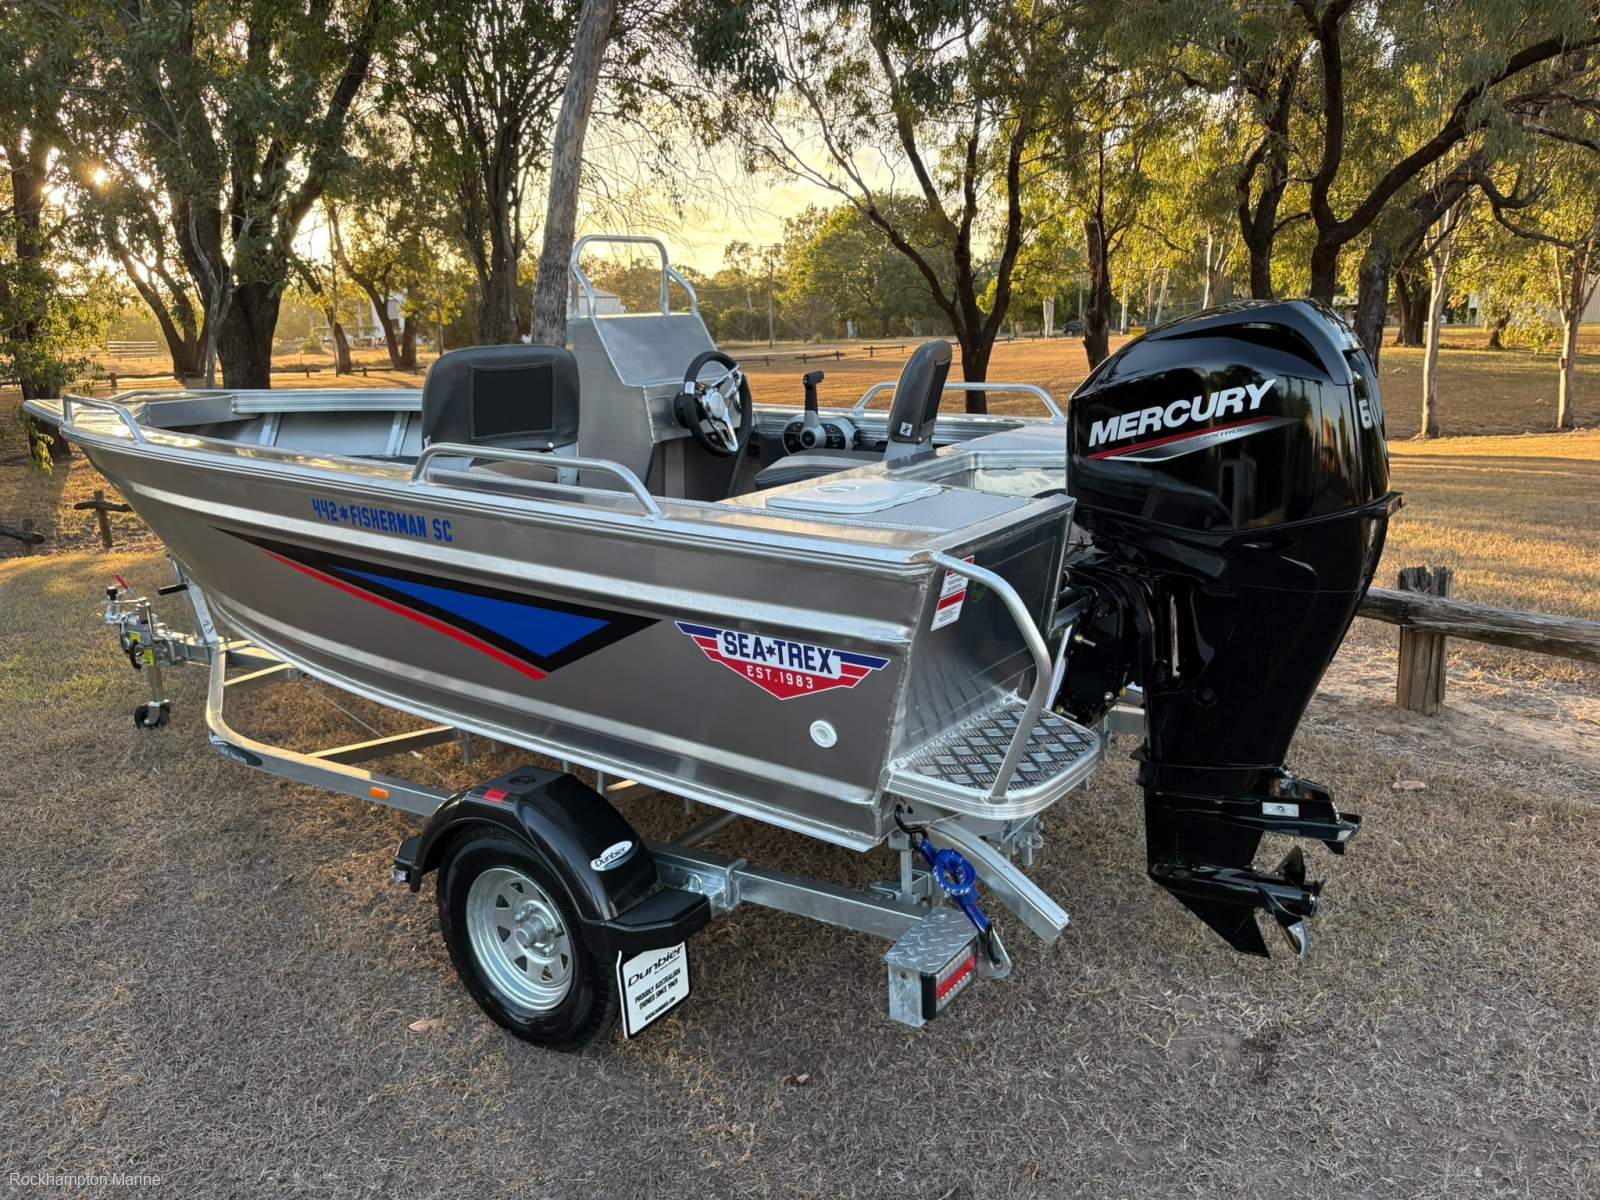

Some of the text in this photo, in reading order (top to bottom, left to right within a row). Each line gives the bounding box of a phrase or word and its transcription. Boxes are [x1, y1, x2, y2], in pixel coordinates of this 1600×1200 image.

[1088, 379, 1276, 447] MERCURY
[312, 497, 453, 542] 442 FISHERMAN SC
[773, 640, 833, 675] TREX
[594, 846, 626, 868] Dunbier
[628, 944, 684, 988] Dunbier
